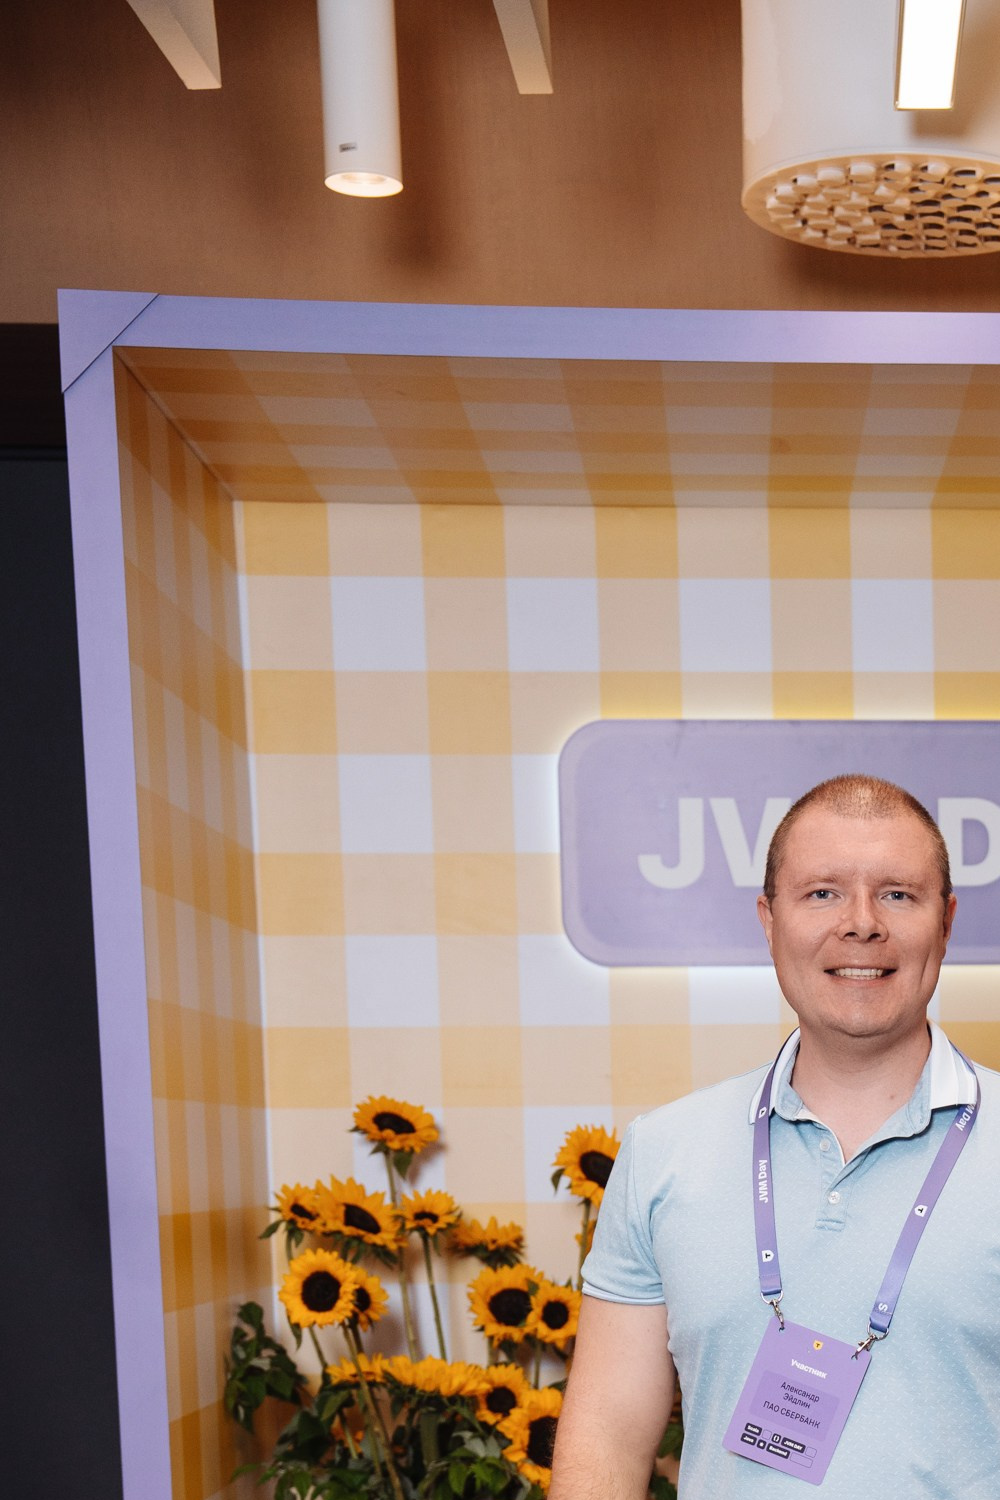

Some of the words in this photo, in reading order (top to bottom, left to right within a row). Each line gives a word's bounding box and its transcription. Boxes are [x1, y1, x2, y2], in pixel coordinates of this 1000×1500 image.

[637, 796, 794, 889] JV
[955, 1111, 971, 1131] Day
[758, 1159, 768, 1180] Day
[758, 1179, 769, 1204] JVM
[791, 1359, 828, 1379] Участник
[781, 1382, 820, 1402] Александр
[783, 1393, 811, 1408] Эйдлин
[763, 1401, 780, 1412] ПАО
[780, 1408, 820, 1428] СБЕРБАНК
